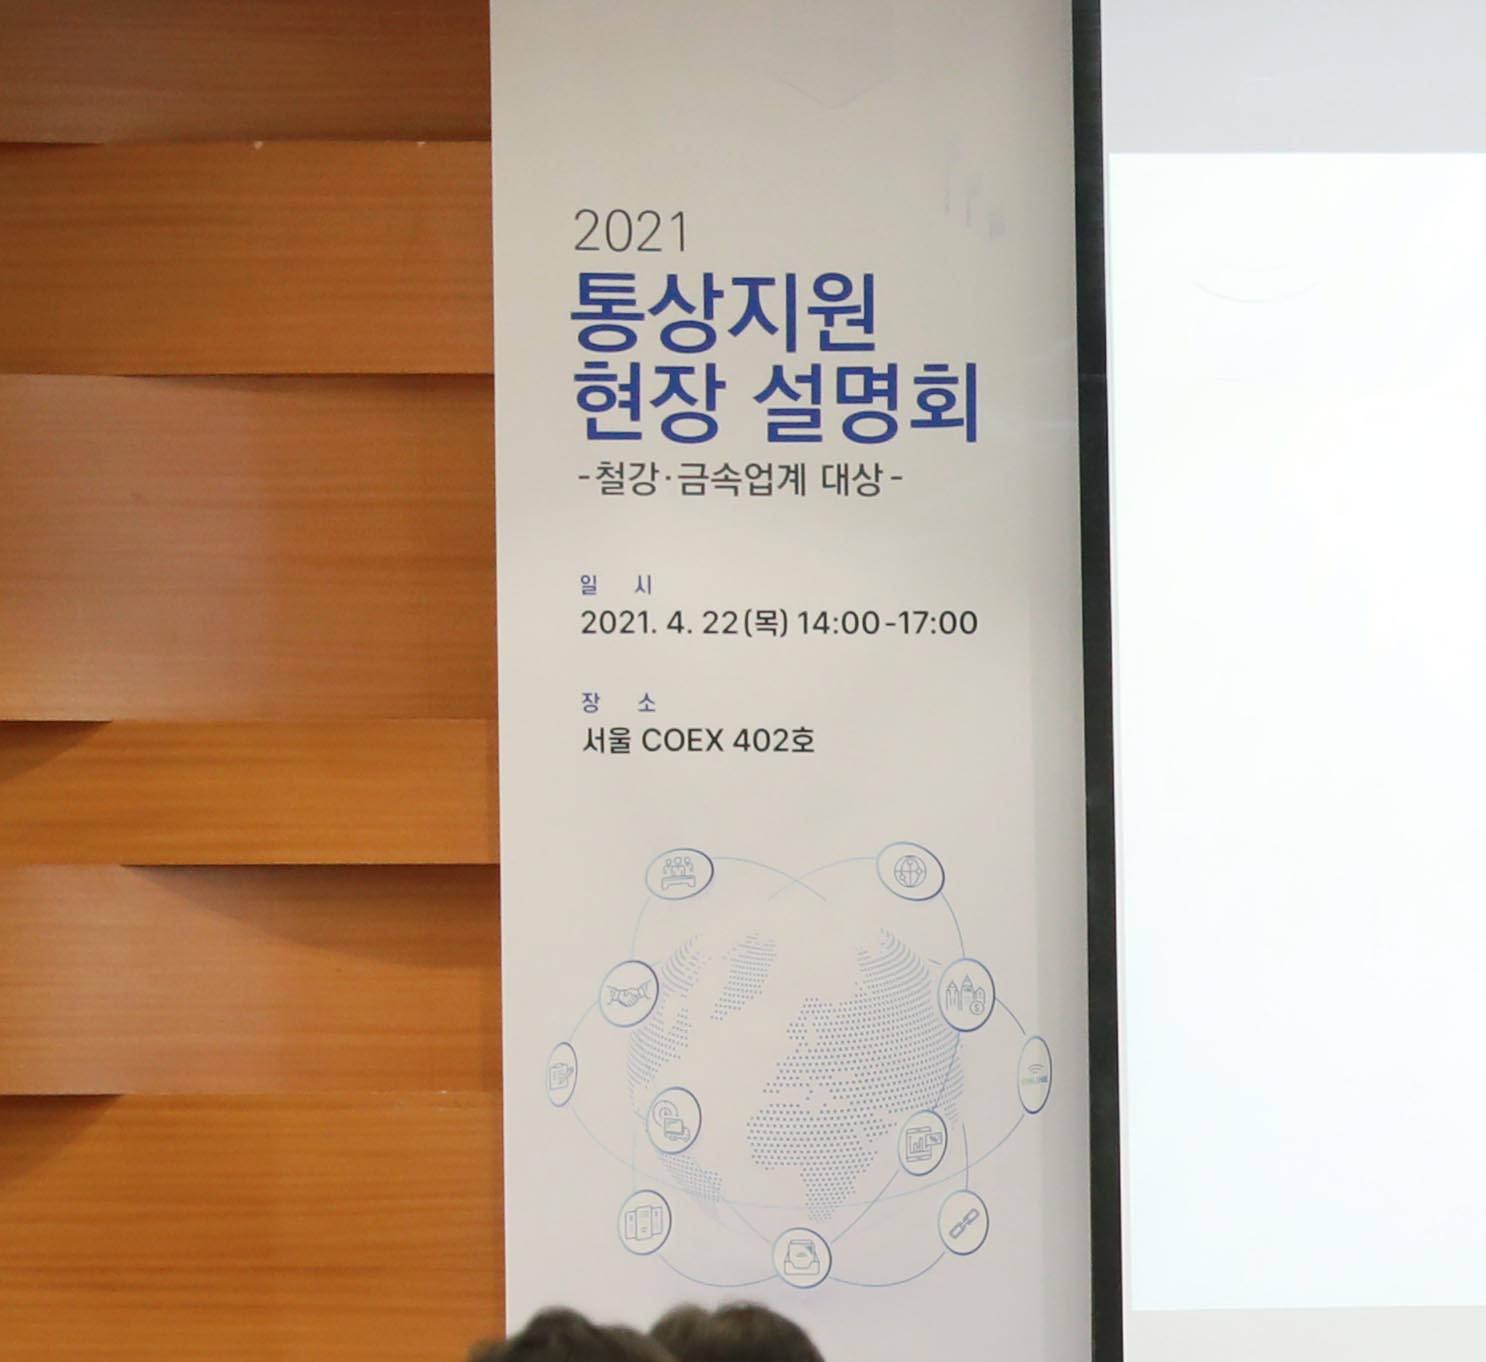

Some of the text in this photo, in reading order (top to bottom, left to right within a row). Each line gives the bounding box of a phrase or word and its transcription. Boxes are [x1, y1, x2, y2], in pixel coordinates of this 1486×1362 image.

[574, 208, 685, 253] 2021
[570, 271, 876, 354] 통상지원
[573, 360, 977, 445] 현장 설명회
[581, 609, 657, 635] 2021.
[666, 610, 693, 634] 4.
[583, 726, 815, 755] 서울 COEX 402호
